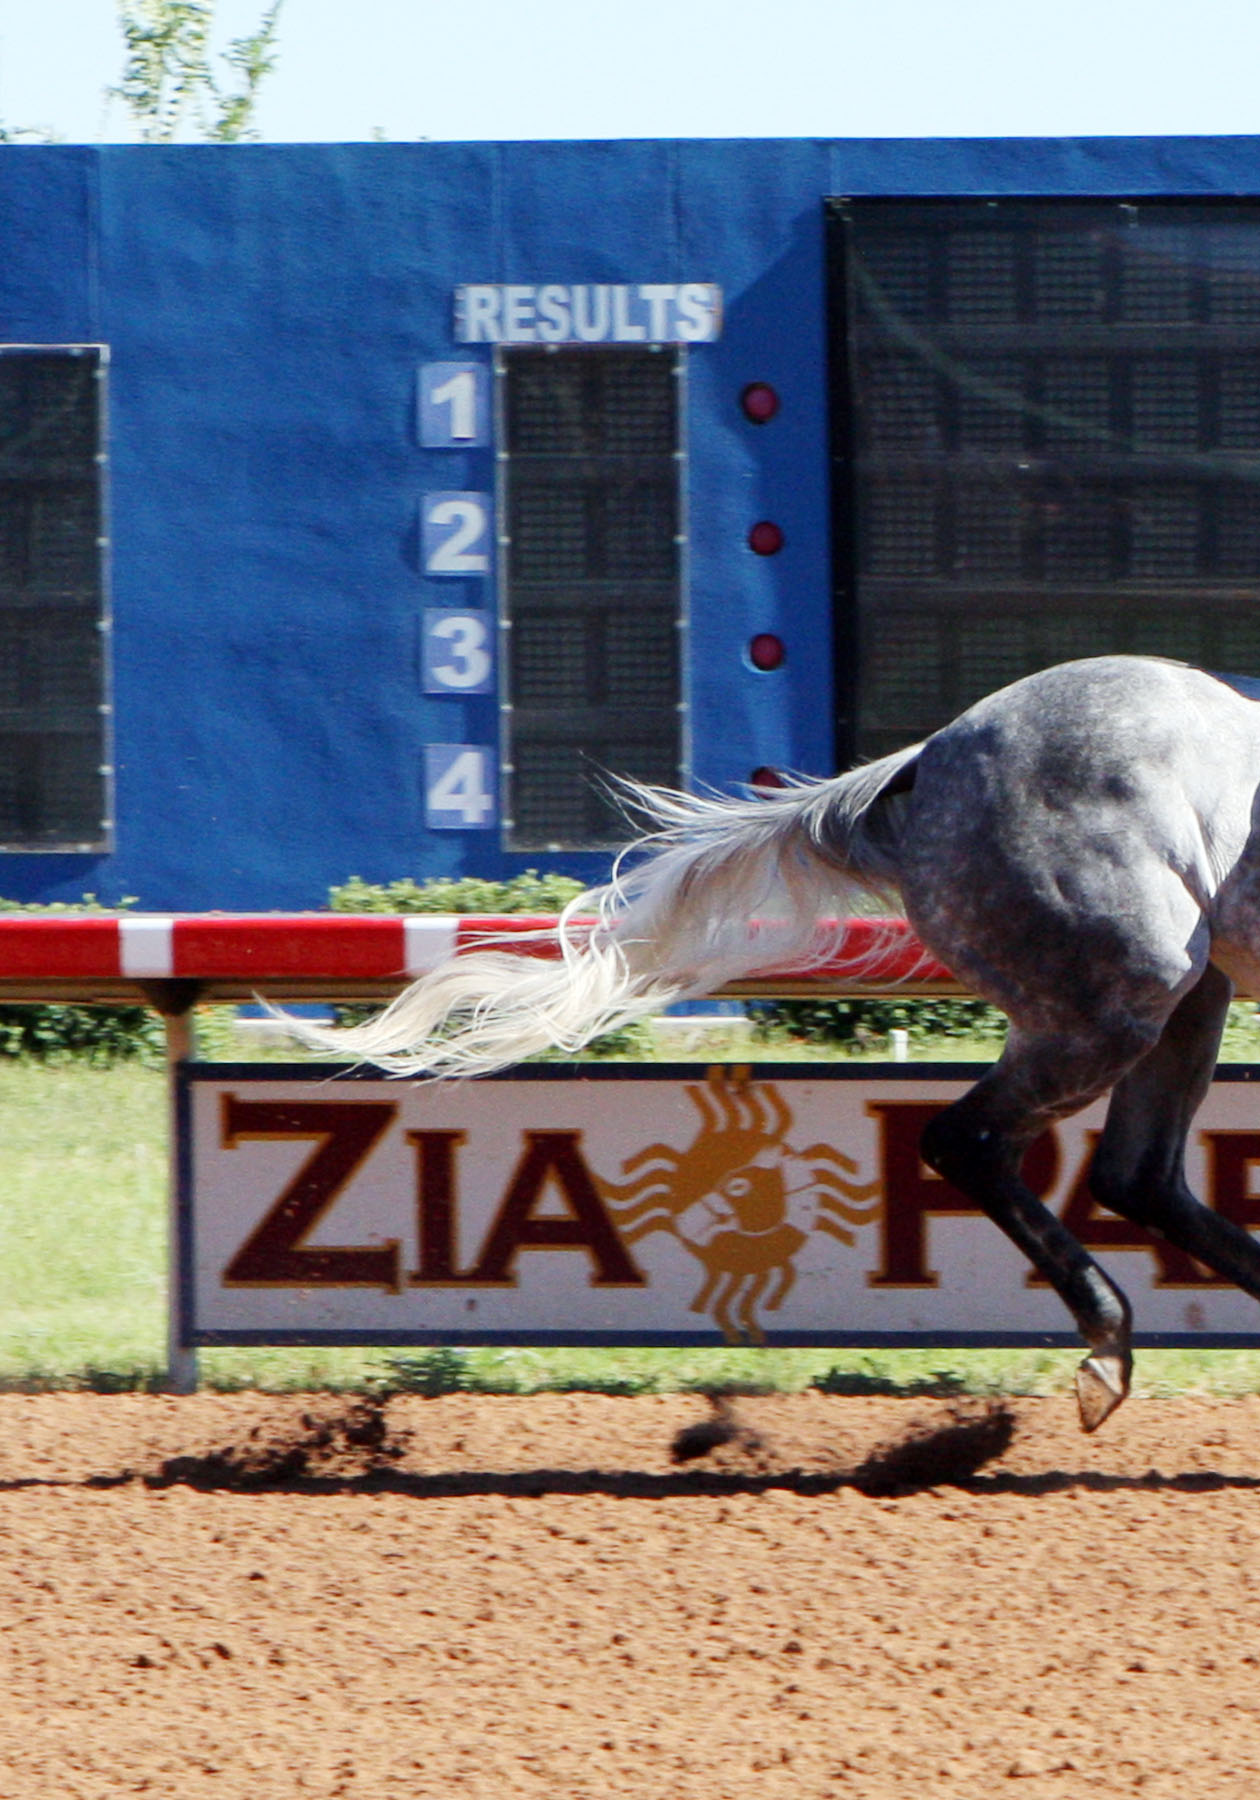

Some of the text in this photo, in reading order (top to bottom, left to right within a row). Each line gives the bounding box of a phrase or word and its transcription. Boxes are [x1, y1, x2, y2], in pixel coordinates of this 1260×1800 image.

[464, 284, 713, 342] RESULTS
[431, 372, 476, 438] 1
[426, 501, 489, 571] 2
[431, 616, 491, 688] 3
[427, 751, 493, 823] 4
[220, 1092, 648, 1294] ZIA
